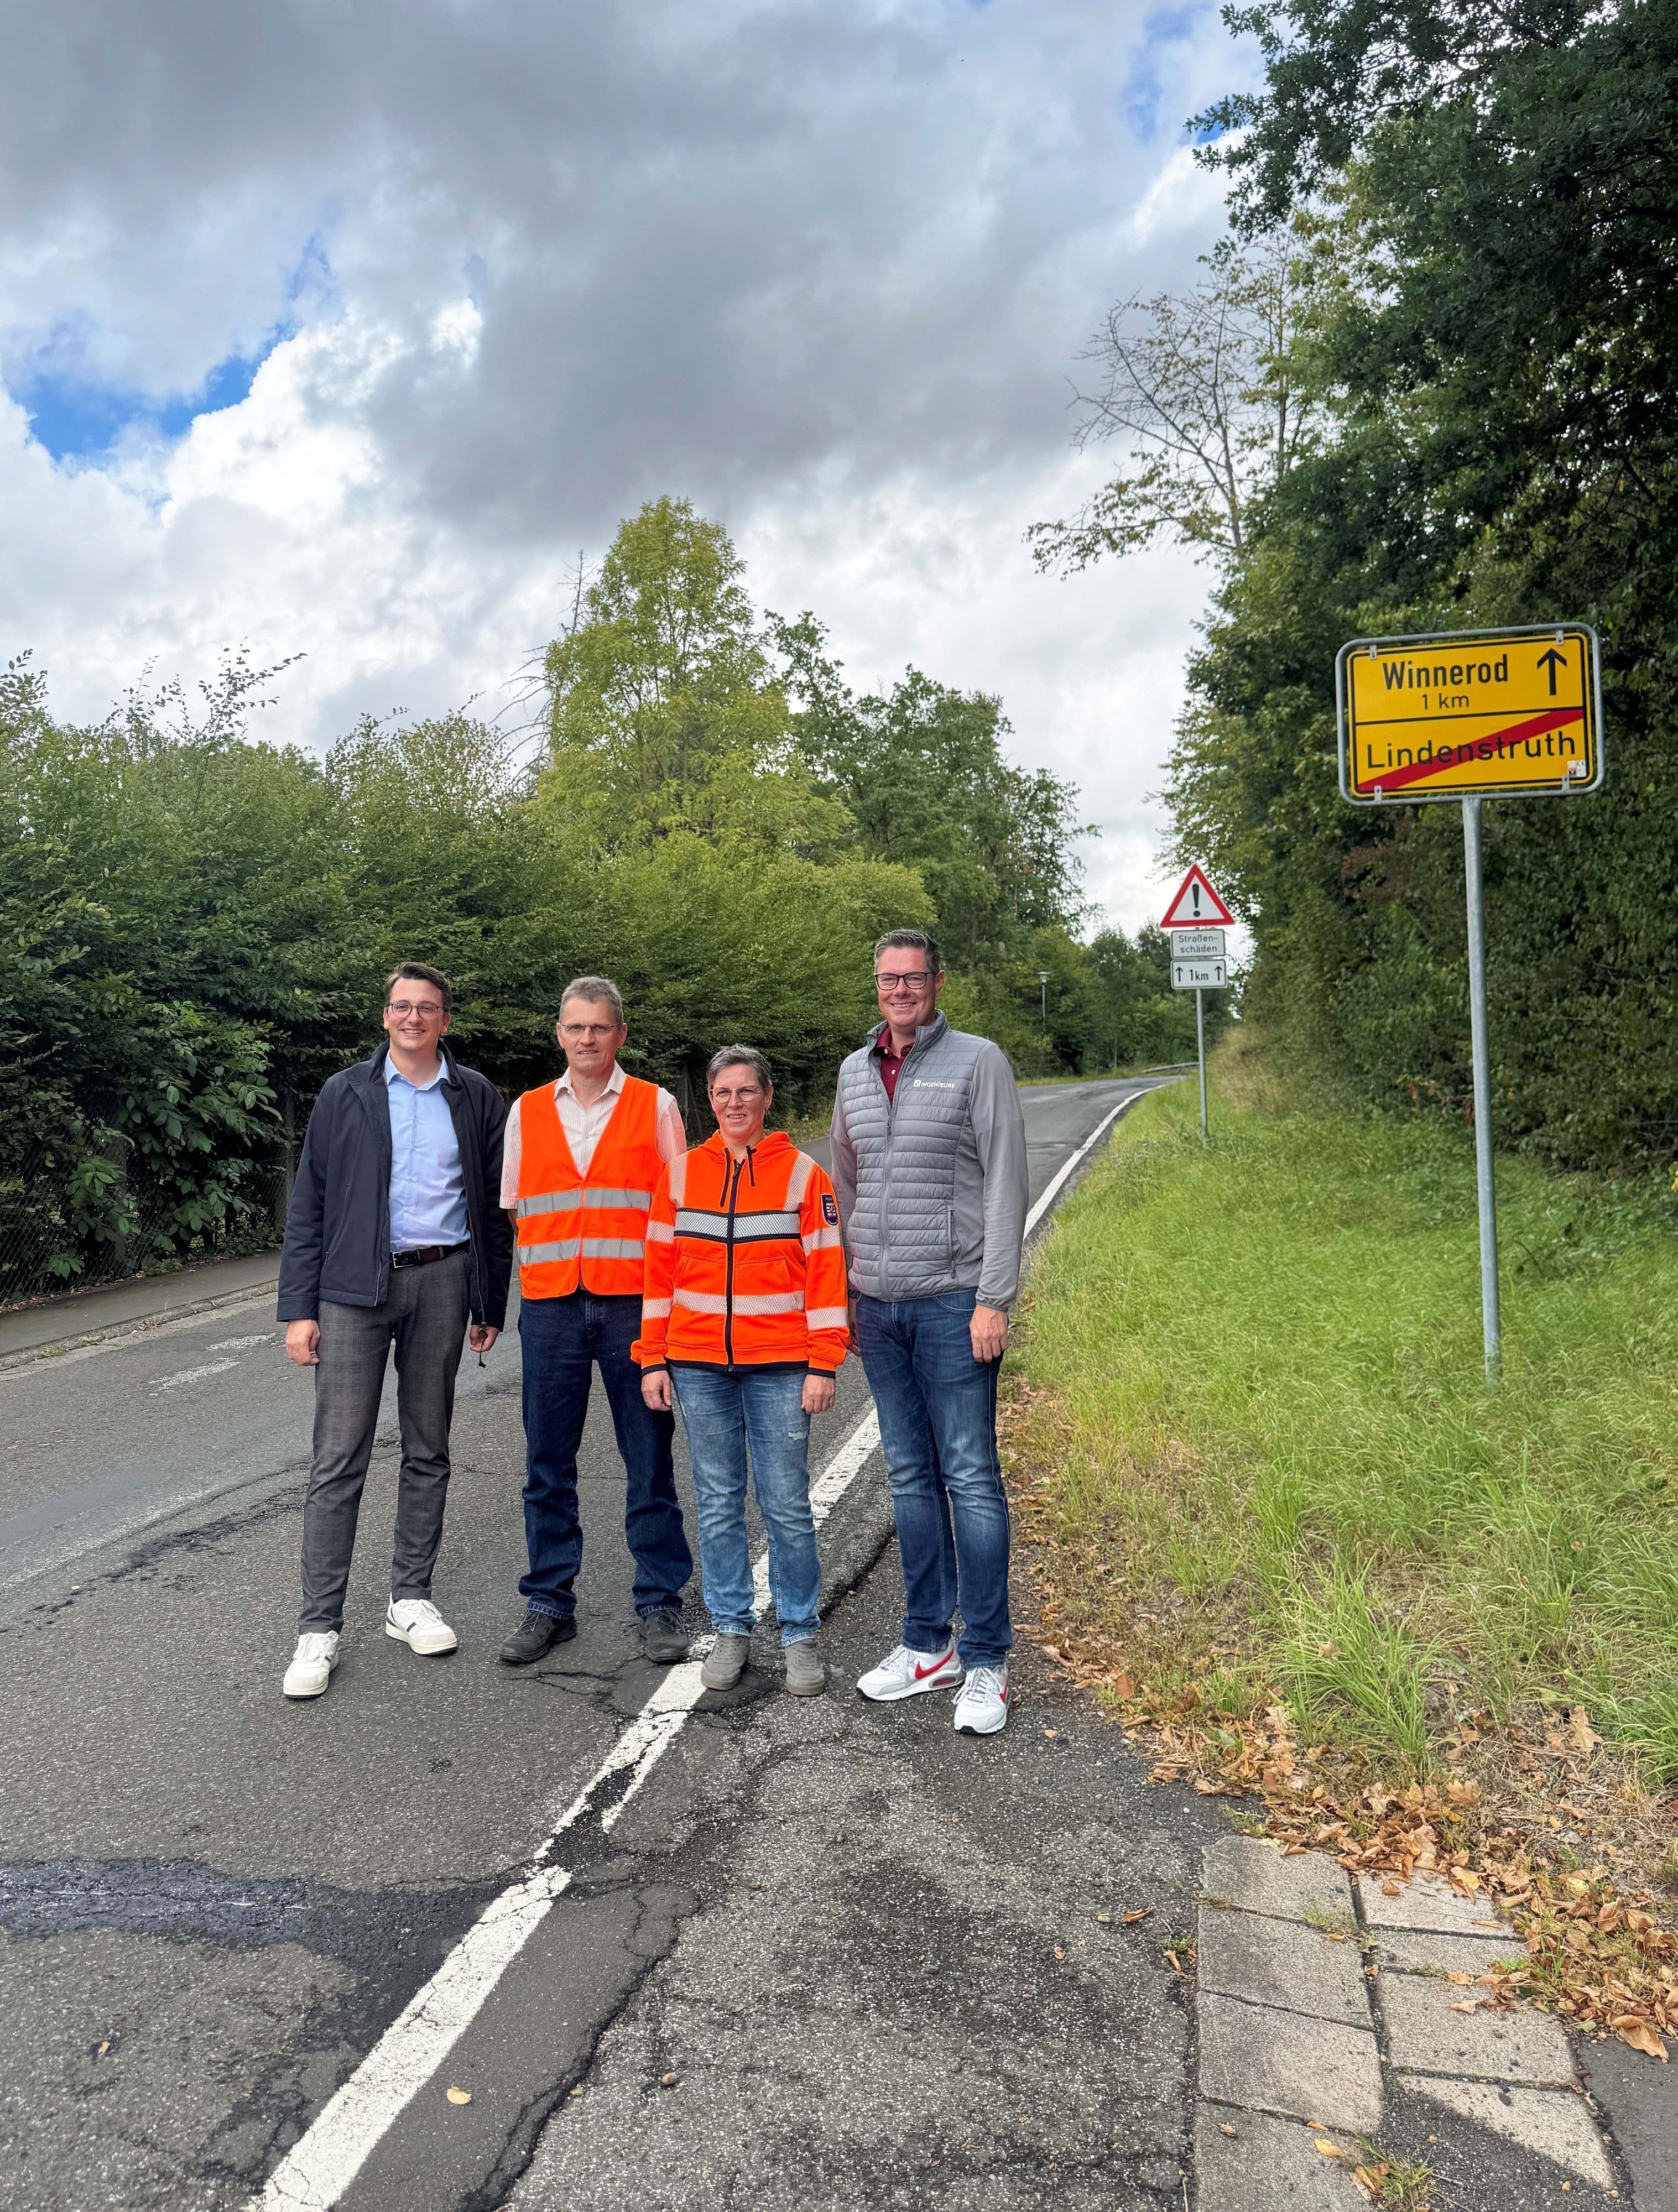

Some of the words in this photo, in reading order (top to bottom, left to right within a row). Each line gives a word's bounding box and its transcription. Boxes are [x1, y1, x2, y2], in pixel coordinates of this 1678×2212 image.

[1383, 654, 1508, 690] Winnerod
[1422, 694, 1428, 710] 1
[1439, 693, 1469, 708] km
[1367, 731, 1575, 768] Lindenstruth
[1178, 934, 1218, 943] Straßen-
[1180, 945, 1217, 953] schäden
